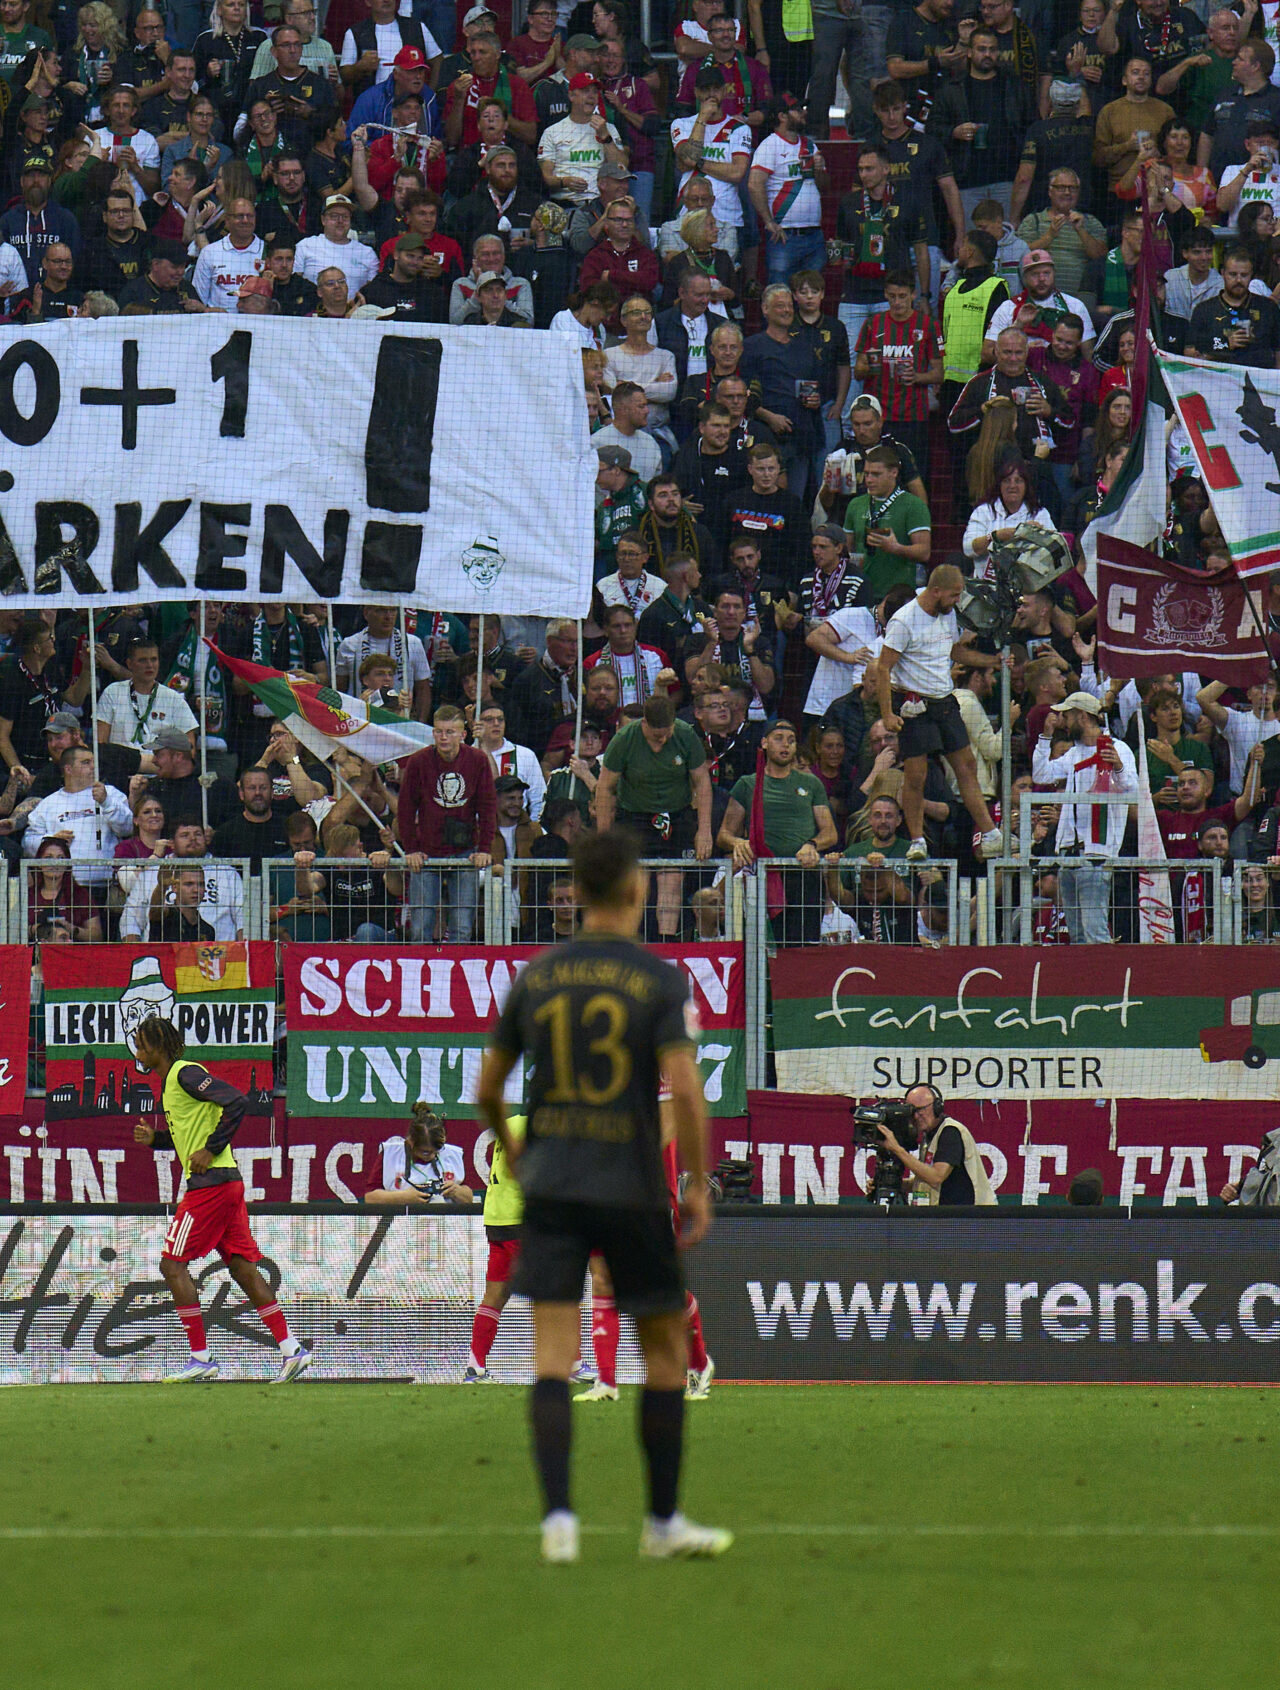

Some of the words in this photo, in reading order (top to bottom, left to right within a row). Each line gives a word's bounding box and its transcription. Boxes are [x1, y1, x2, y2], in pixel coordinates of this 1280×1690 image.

[570, 149, 602, 162] WWK
[1241, 188, 1274, 200] WWK
[883, 344, 914, 358] WWK
[1106, 583, 1137, 634] C
[335, 719, 359, 732] 1907
[815, 961, 1144, 1036] fanfahrt
[52, 1003, 117, 1045] LECH
[178, 1002, 269, 1044] POWER
[532, 991, 634, 1106] 13
[873, 1056, 1104, 1090] SUPPORTER
